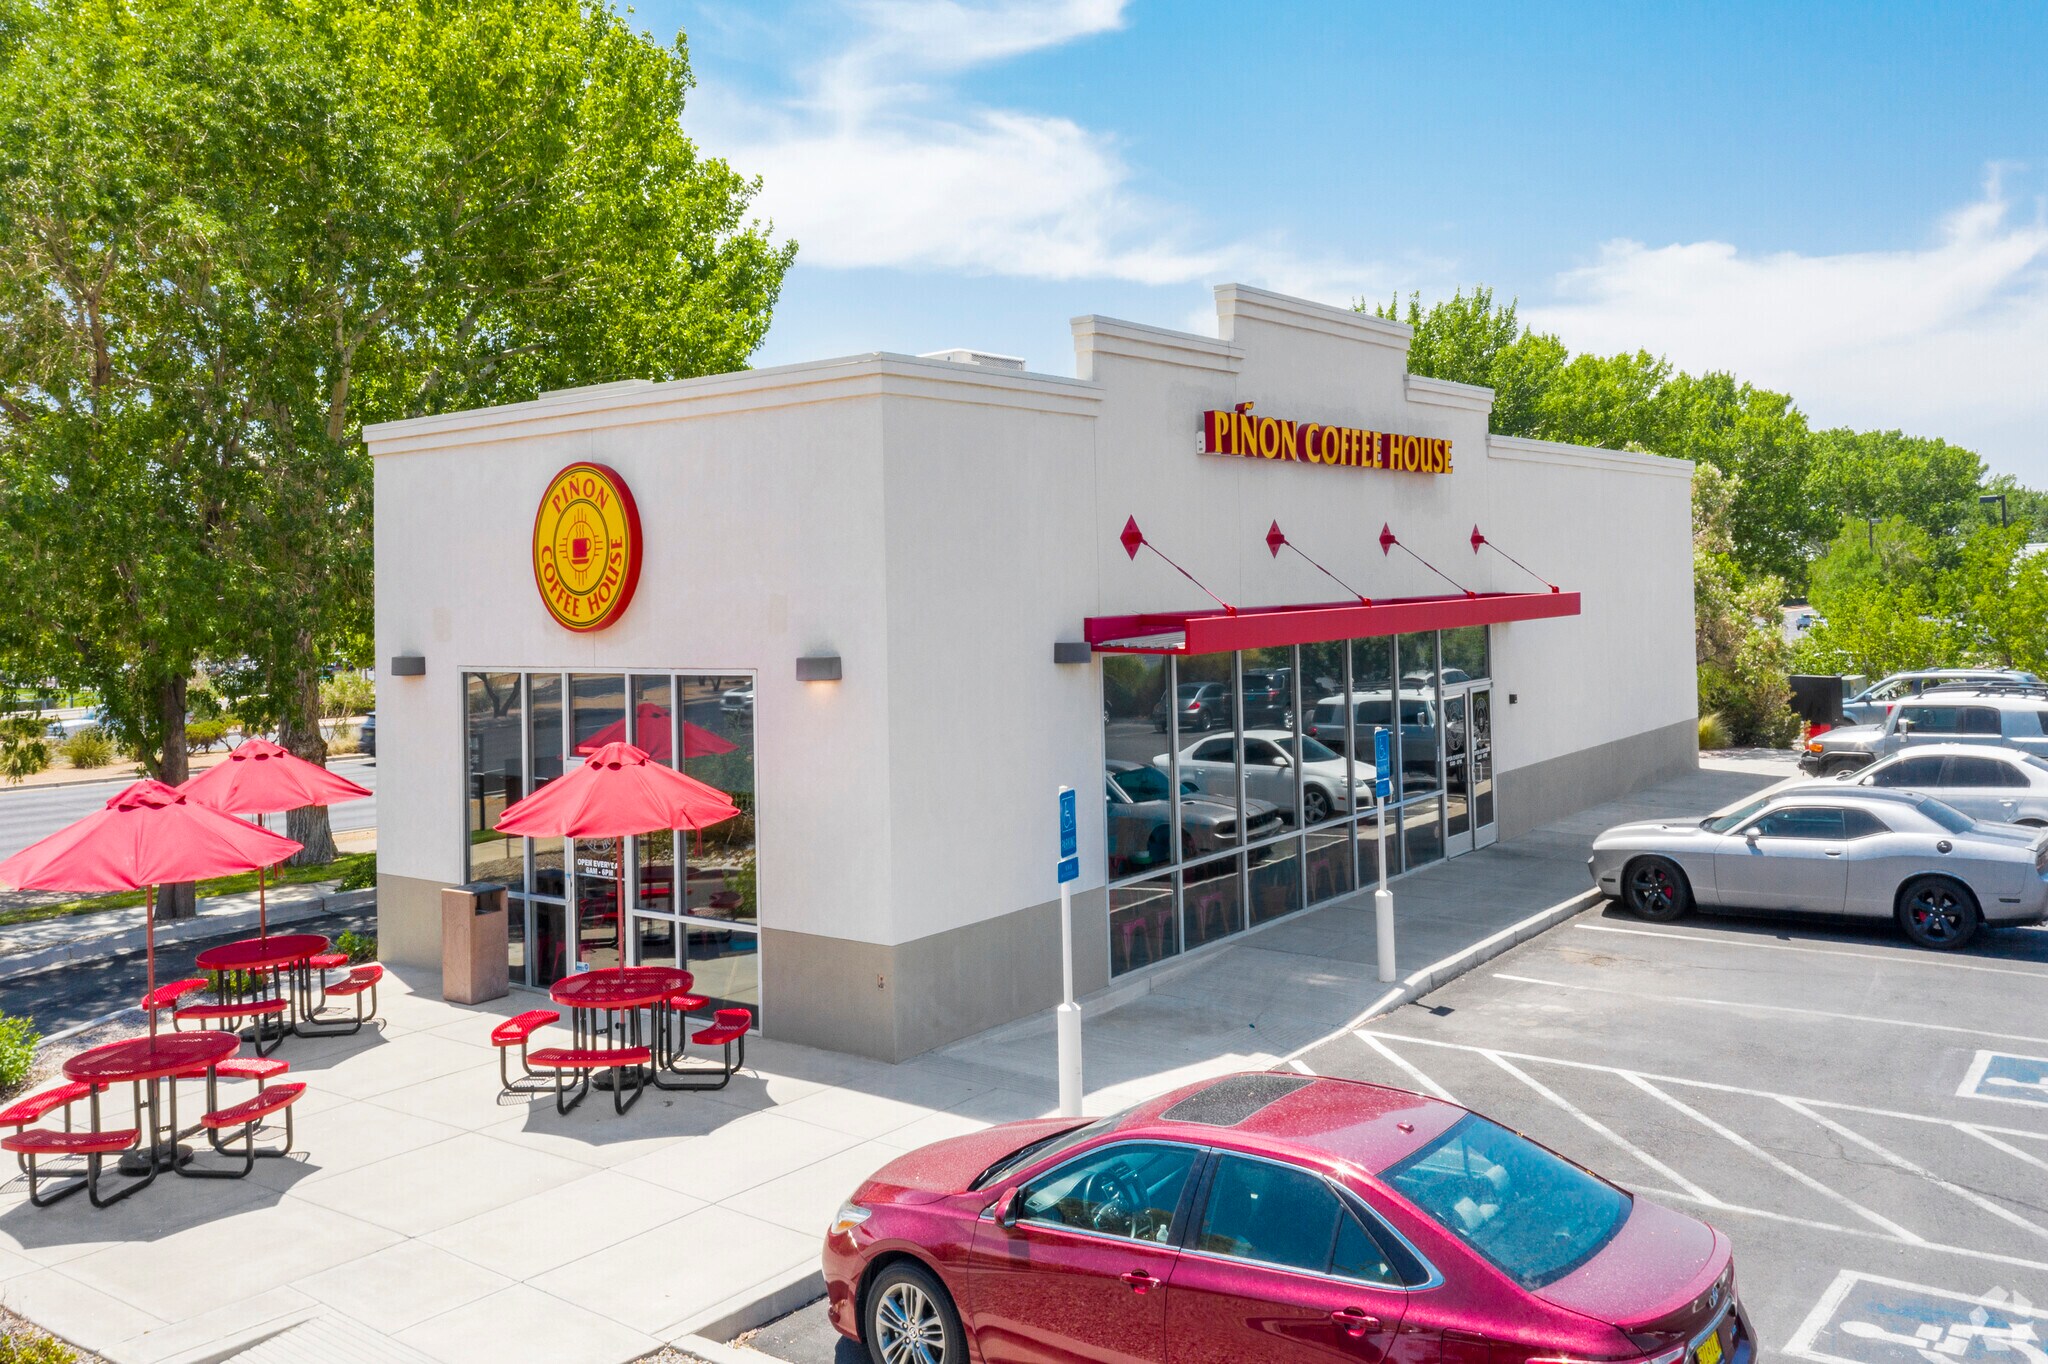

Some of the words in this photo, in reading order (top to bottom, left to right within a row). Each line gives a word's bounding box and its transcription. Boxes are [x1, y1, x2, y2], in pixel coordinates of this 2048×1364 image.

[1210, 401, 1298, 462] PIÑON
[1301, 422, 1383, 466] COFFEE
[1389, 432, 1454, 474] HOUSE
[551, 474, 610, 514] PIÑON
[541, 545, 580, 617] COFFEE
[586, 536, 623, 615] HOUSE
[593, 860, 618, 869] EVERYDA
